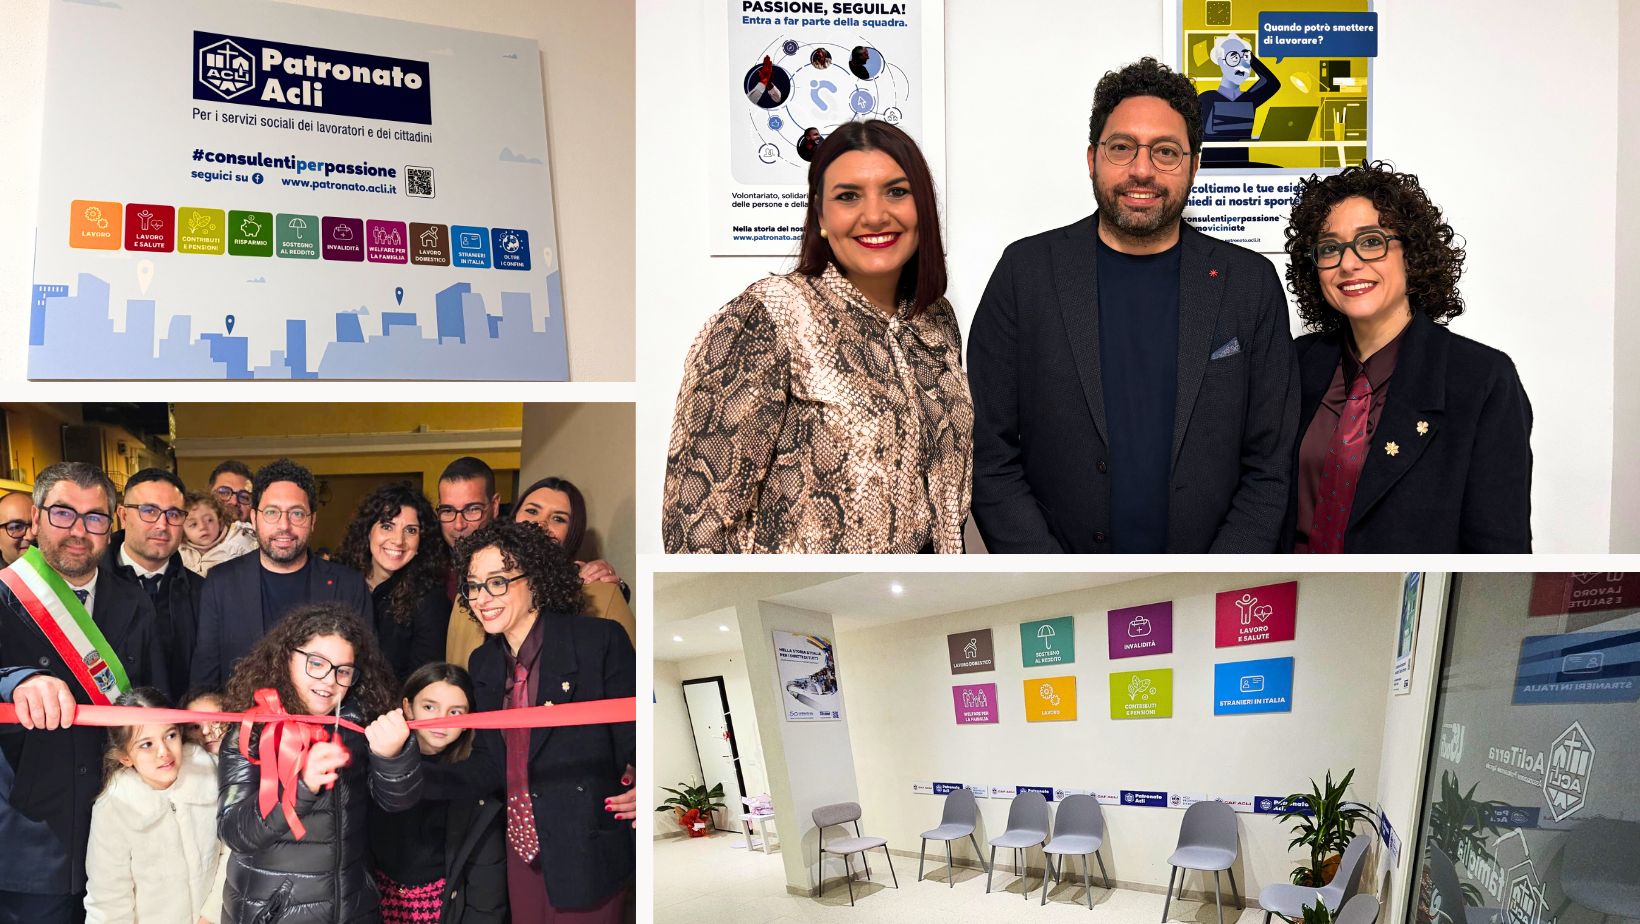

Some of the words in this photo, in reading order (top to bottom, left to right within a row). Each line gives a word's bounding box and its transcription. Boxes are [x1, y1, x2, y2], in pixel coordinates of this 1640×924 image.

[742, 1, 828, 16] PASSIONE,
[832, 2, 906, 15] SEGUILA!
[742, 16, 772, 25] Entra
[783, 16, 799, 26] far
[802, 17, 831, 28] parte
[833, 17, 860, 27] della
[862, 17, 908, 28] squadra.
[1263, 23, 1301, 32] Quando
[1304, 22, 1330, 34] potrò
[1332, 23, 1374, 32] smettere
[1263, 36, 1273, 45] di
[1275, 36, 1324, 45] lavorare?
[207, 68, 249, 81] ACLI
[261, 47, 422, 90] Patronato
[260, 78, 323, 107] Acli
[192, 108, 212, 121] Per
[222, 111, 257, 126] servizi
[261, 116, 294, 130] sociali
[298, 120, 313, 132] dei
[317, 121, 364, 136] lavoratori
[368, 129, 373, 138] e
[376, 128, 391, 140] dei
[394, 130, 432, 143] cittadini
[192, 149, 397, 178] #consulentiperpassione
[191, 169, 232, 183] seguici
[235, 174, 249, 182] su
[282, 178, 397, 194] www.patronato.acli.it
[1191, 183, 1241, 194] coltiamo
[1243, 183, 1254, 193] le
[1256, 184, 1274, 193] tue
[731, 192, 780, 200] Volontariato,
[1186, 196, 1212, 206] hiedi
[1215, 196, 1226, 206] ai
[1228, 195, 1261, 206] nostri
[1264, 196, 1302, 208] sporte
[182, 236, 220, 244] CONTRIBUTI
[234, 238, 268, 246] RISPARMIO
[1240, 625, 1268, 634] LAVORO
[1243, 633, 1270, 642] SALUTE
[1123, 641, 1156, 650] INVALIDITÀ
[1219, 698, 1253, 706] STRANIERI
